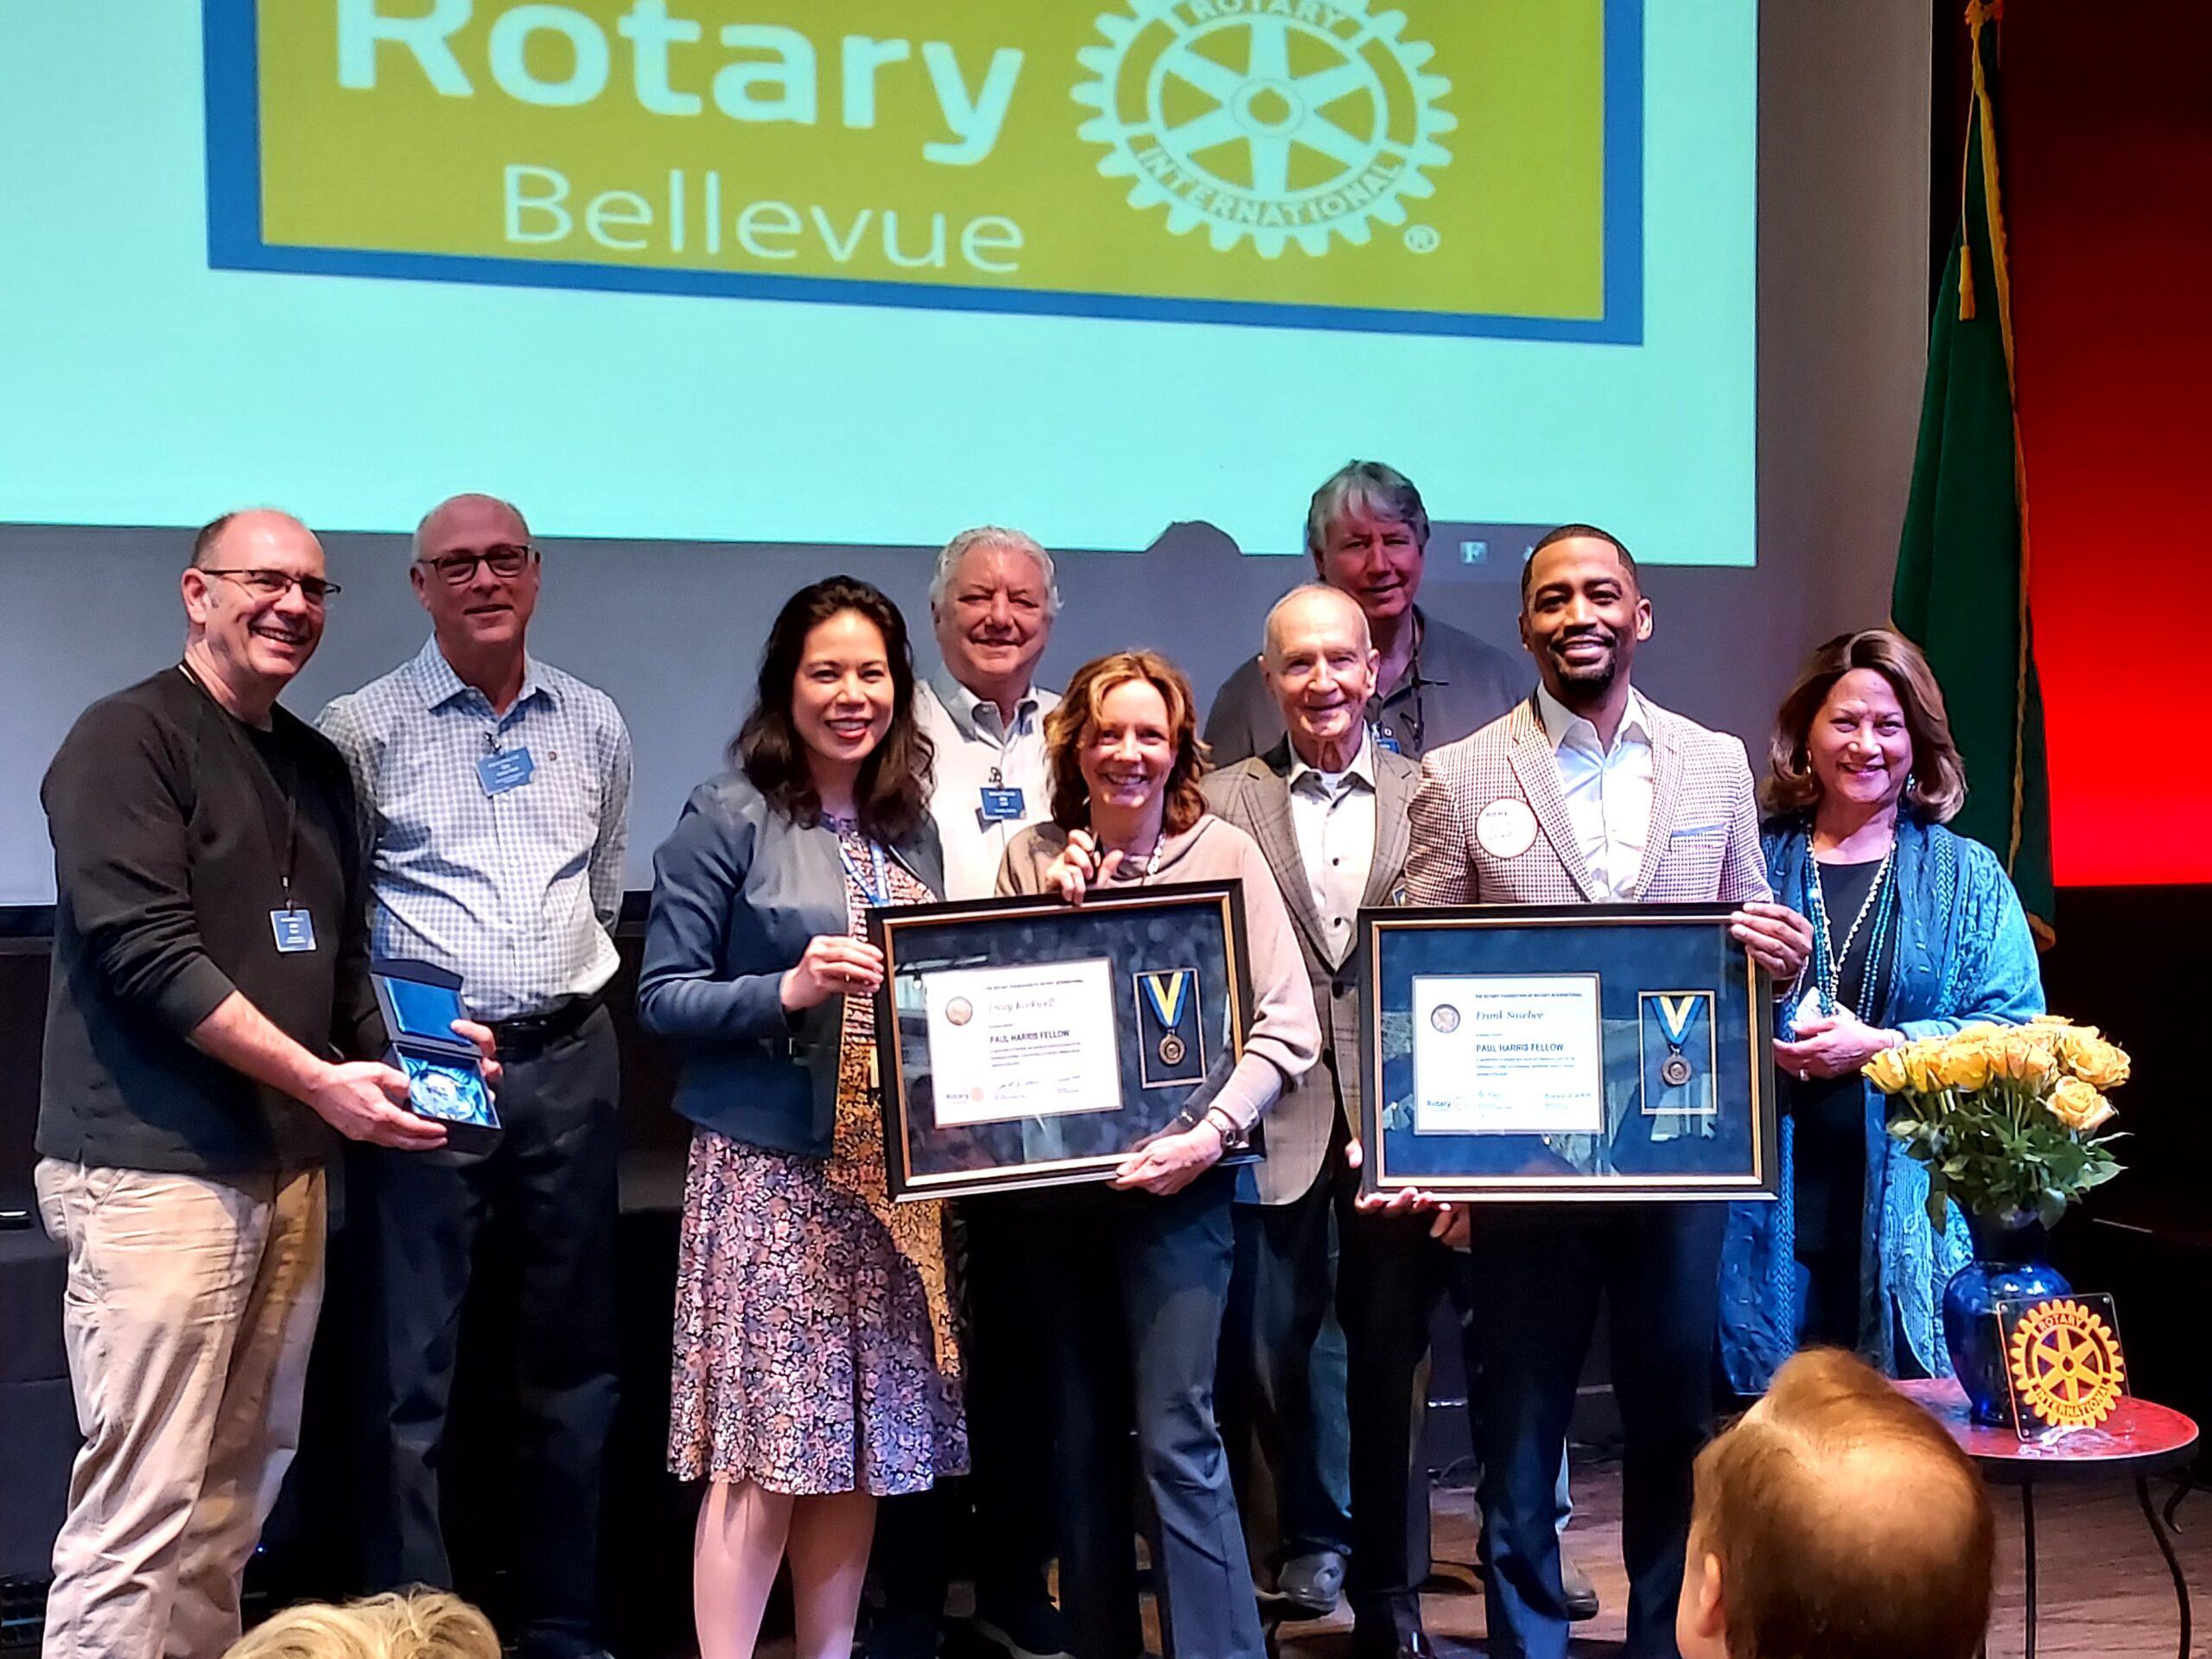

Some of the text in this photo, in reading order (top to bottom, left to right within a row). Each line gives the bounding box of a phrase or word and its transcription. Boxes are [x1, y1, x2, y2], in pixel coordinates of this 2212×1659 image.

[336, 0, 1025, 166] Rotary
[1135, 146, 1406, 228] INTERNATIONAL
[504, 164, 1025, 271] Bellevue
[1011, 1033, 1038, 1042] HARRIS
[1039, 1029, 1070, 1039] FELLOW
[1476, 1043, 1564, 1052] PAUL HARRIS FELLOW
[2038, 1313, 2085, 1332] ROTARY
[2034, 1380, 2112, 1417] INTERNATIONAL
